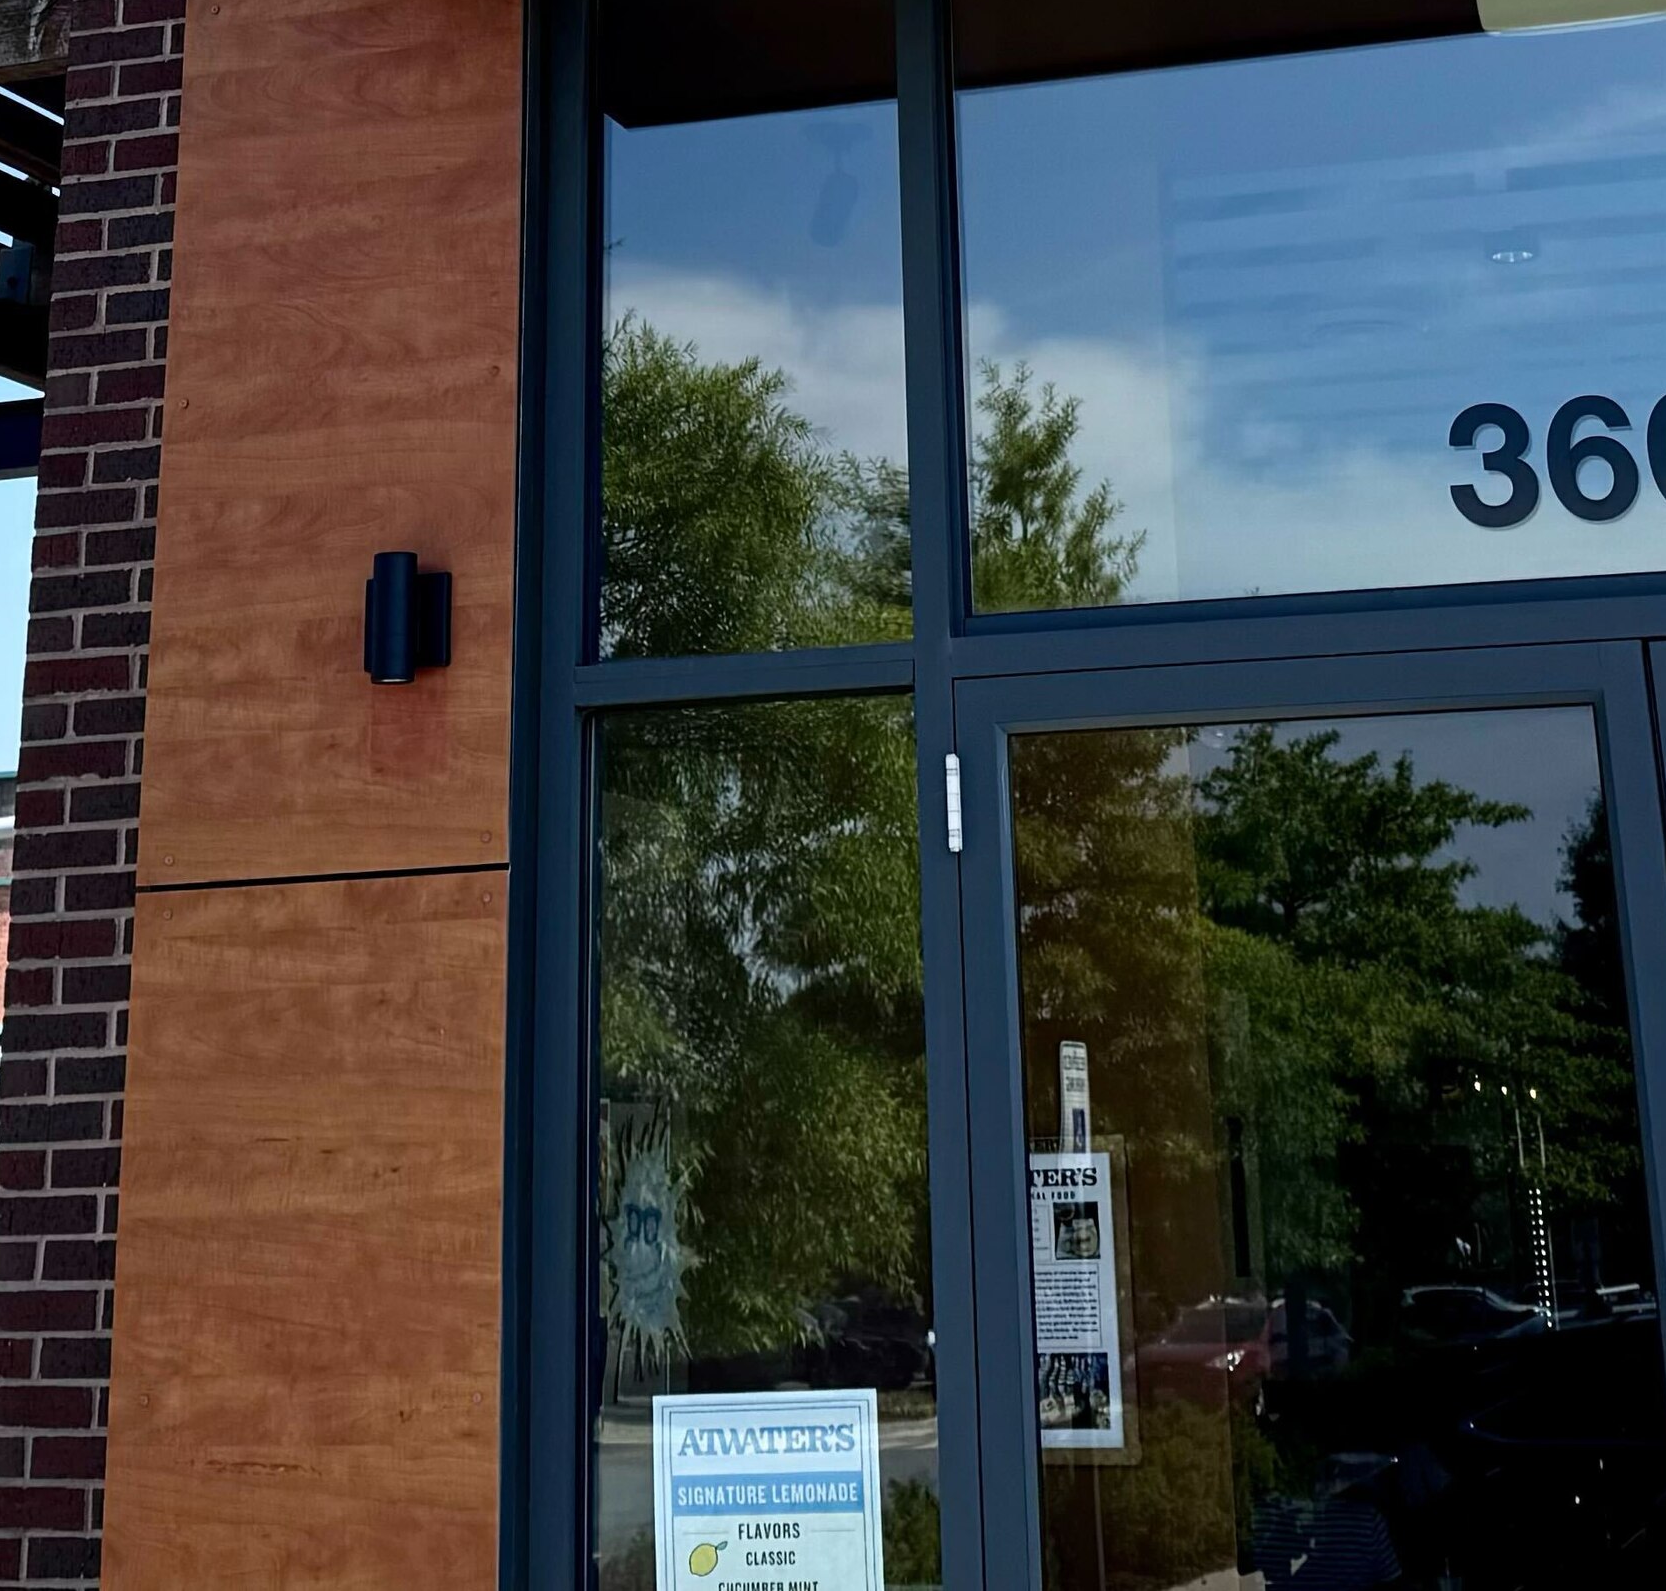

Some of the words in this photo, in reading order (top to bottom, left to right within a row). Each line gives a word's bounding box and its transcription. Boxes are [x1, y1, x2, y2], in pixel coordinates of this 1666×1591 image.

[677, 1423, 856, 1456] ATWATER'S
[677, 1485, 766, 1506] SIGNATURE
[772, 1482, 858, 1504] LEMONADE
[737, 1522, 801, 1541] FLAVORS
[745, 1550, 796, 1566] CLASSIC
